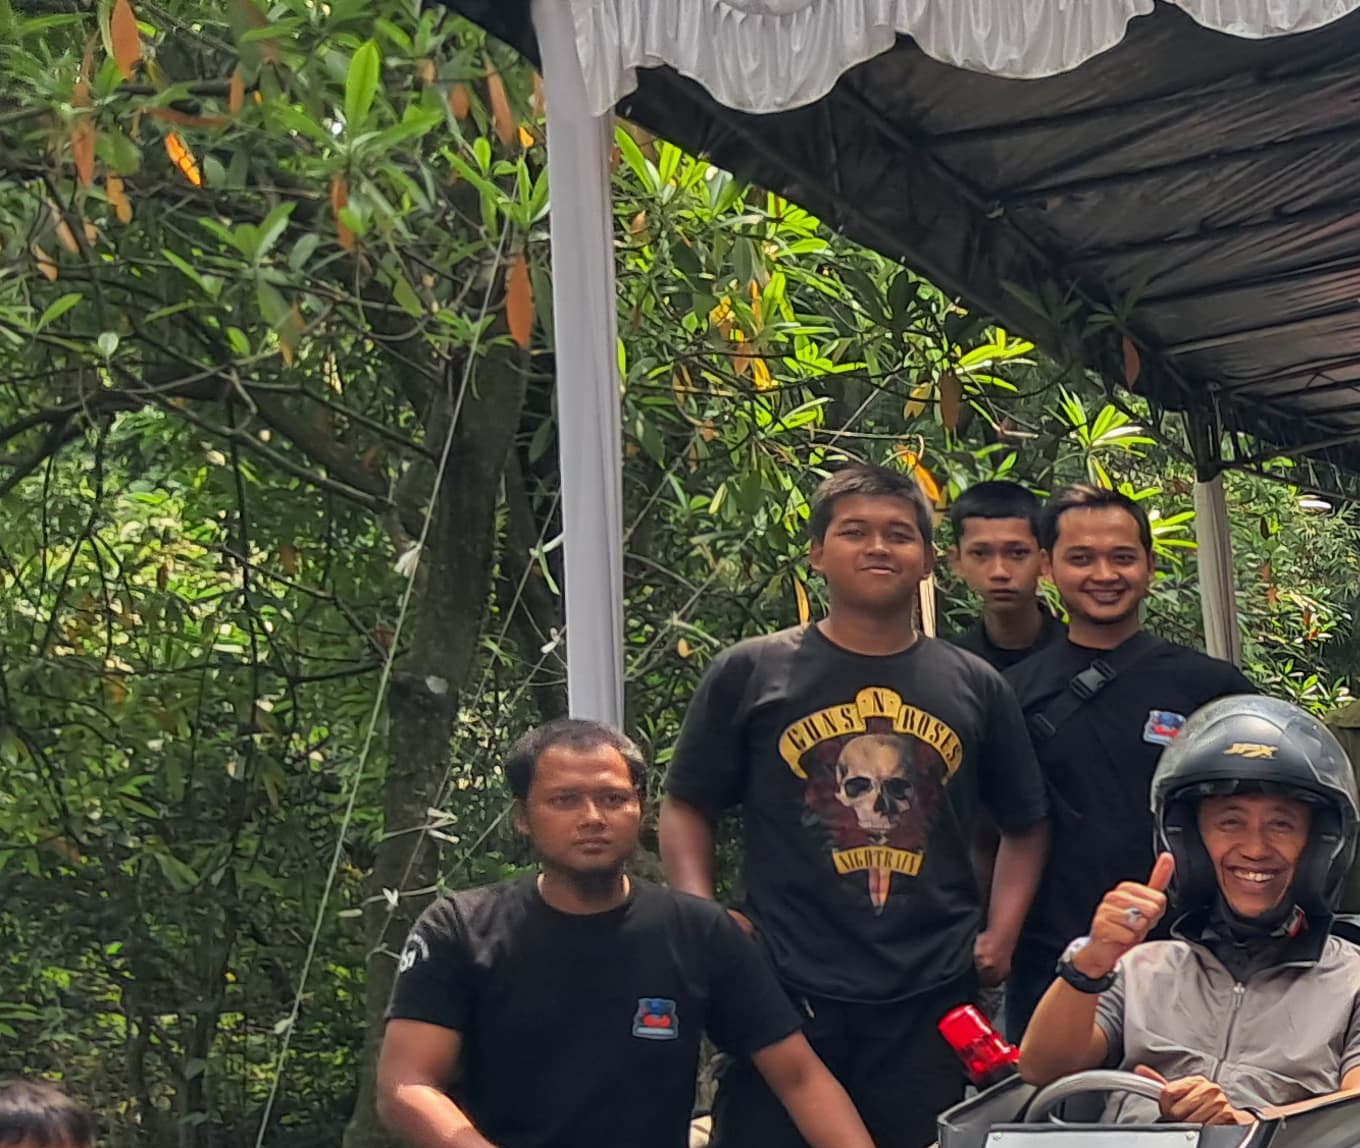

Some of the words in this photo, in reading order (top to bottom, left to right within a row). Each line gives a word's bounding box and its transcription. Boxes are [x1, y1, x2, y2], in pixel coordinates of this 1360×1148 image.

[786, 707, 855, 750] GUNS
[871, 691, 885, 713] N
[902, 707, 960, 762] ROSES
[838, 850, 916, 872] NIGHTRAIN
